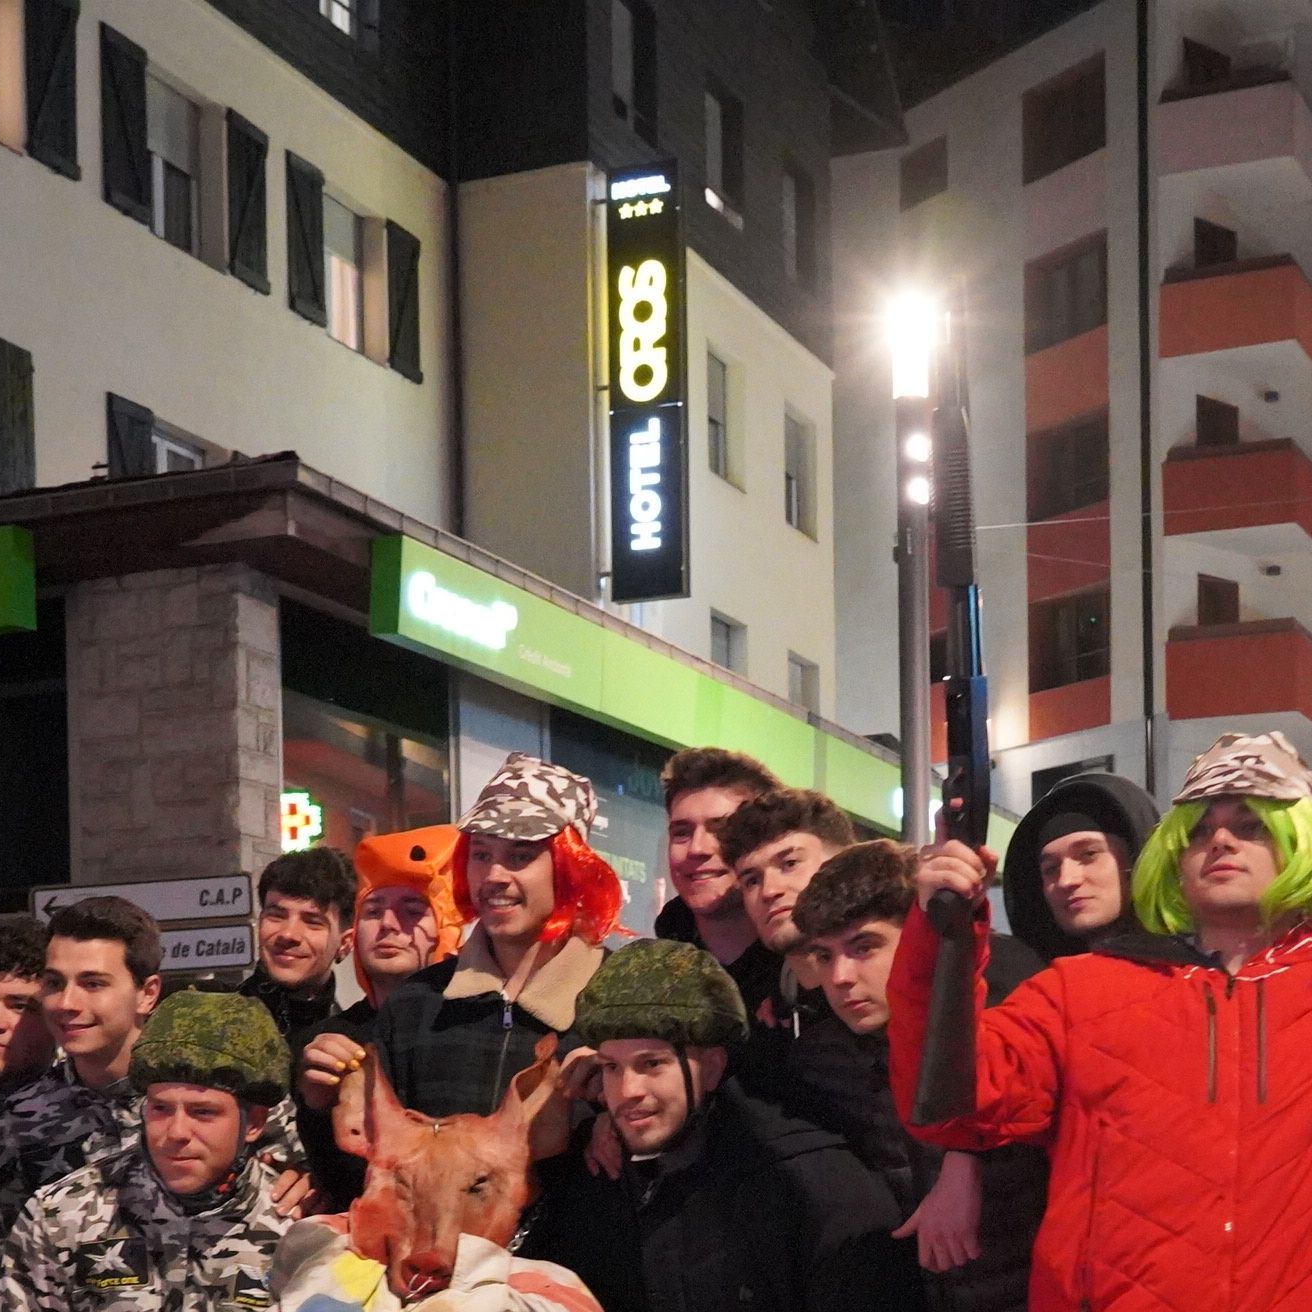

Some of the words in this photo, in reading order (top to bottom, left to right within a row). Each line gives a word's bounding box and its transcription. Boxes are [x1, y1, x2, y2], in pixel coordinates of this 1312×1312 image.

[618, 259, 668, 402] OROS
[629, 416, 662, 551] HOTEL
[199, 887, 243, 907] C.A.P
[171, 942, 191, 958] de
[195, 938, 246, 957] Català
